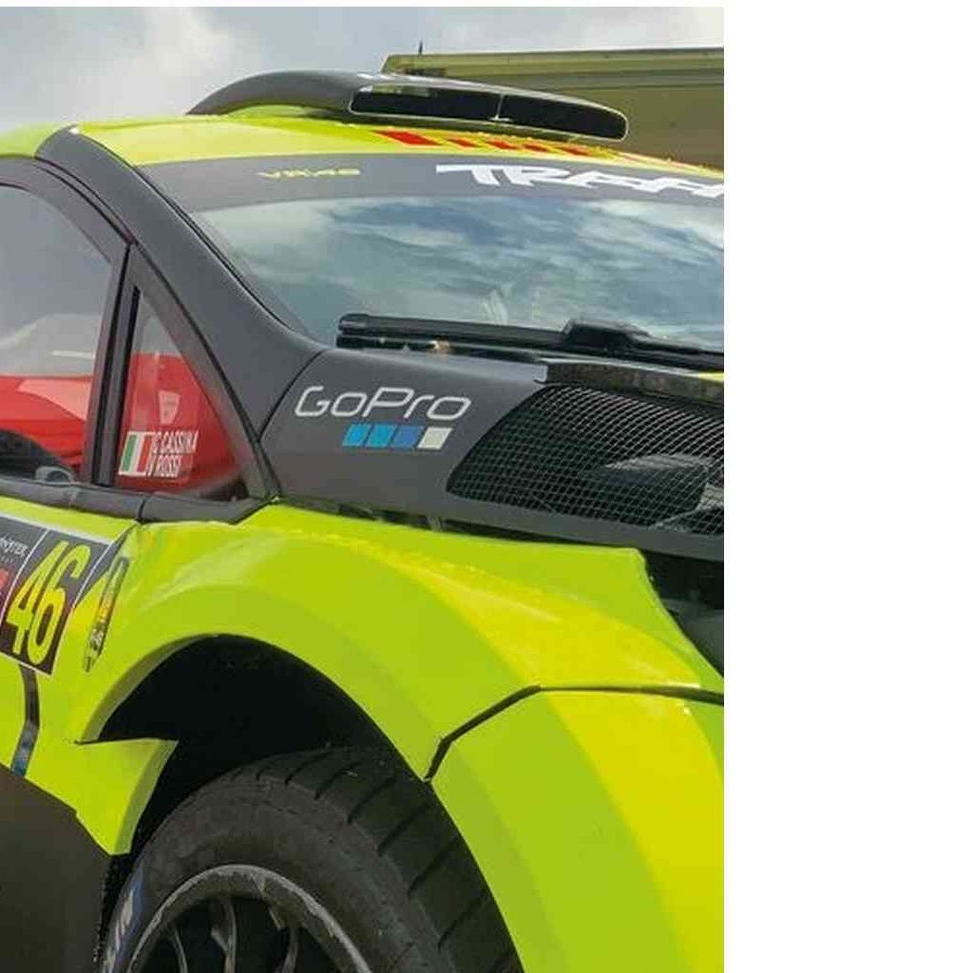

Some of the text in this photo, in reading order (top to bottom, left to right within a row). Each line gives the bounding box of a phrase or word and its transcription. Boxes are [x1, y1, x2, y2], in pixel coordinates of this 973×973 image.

[295, 385, 472, 421] GoPro
[154, 454, 184, 478] ROSSI
[6, 540, 91, 666] 46
